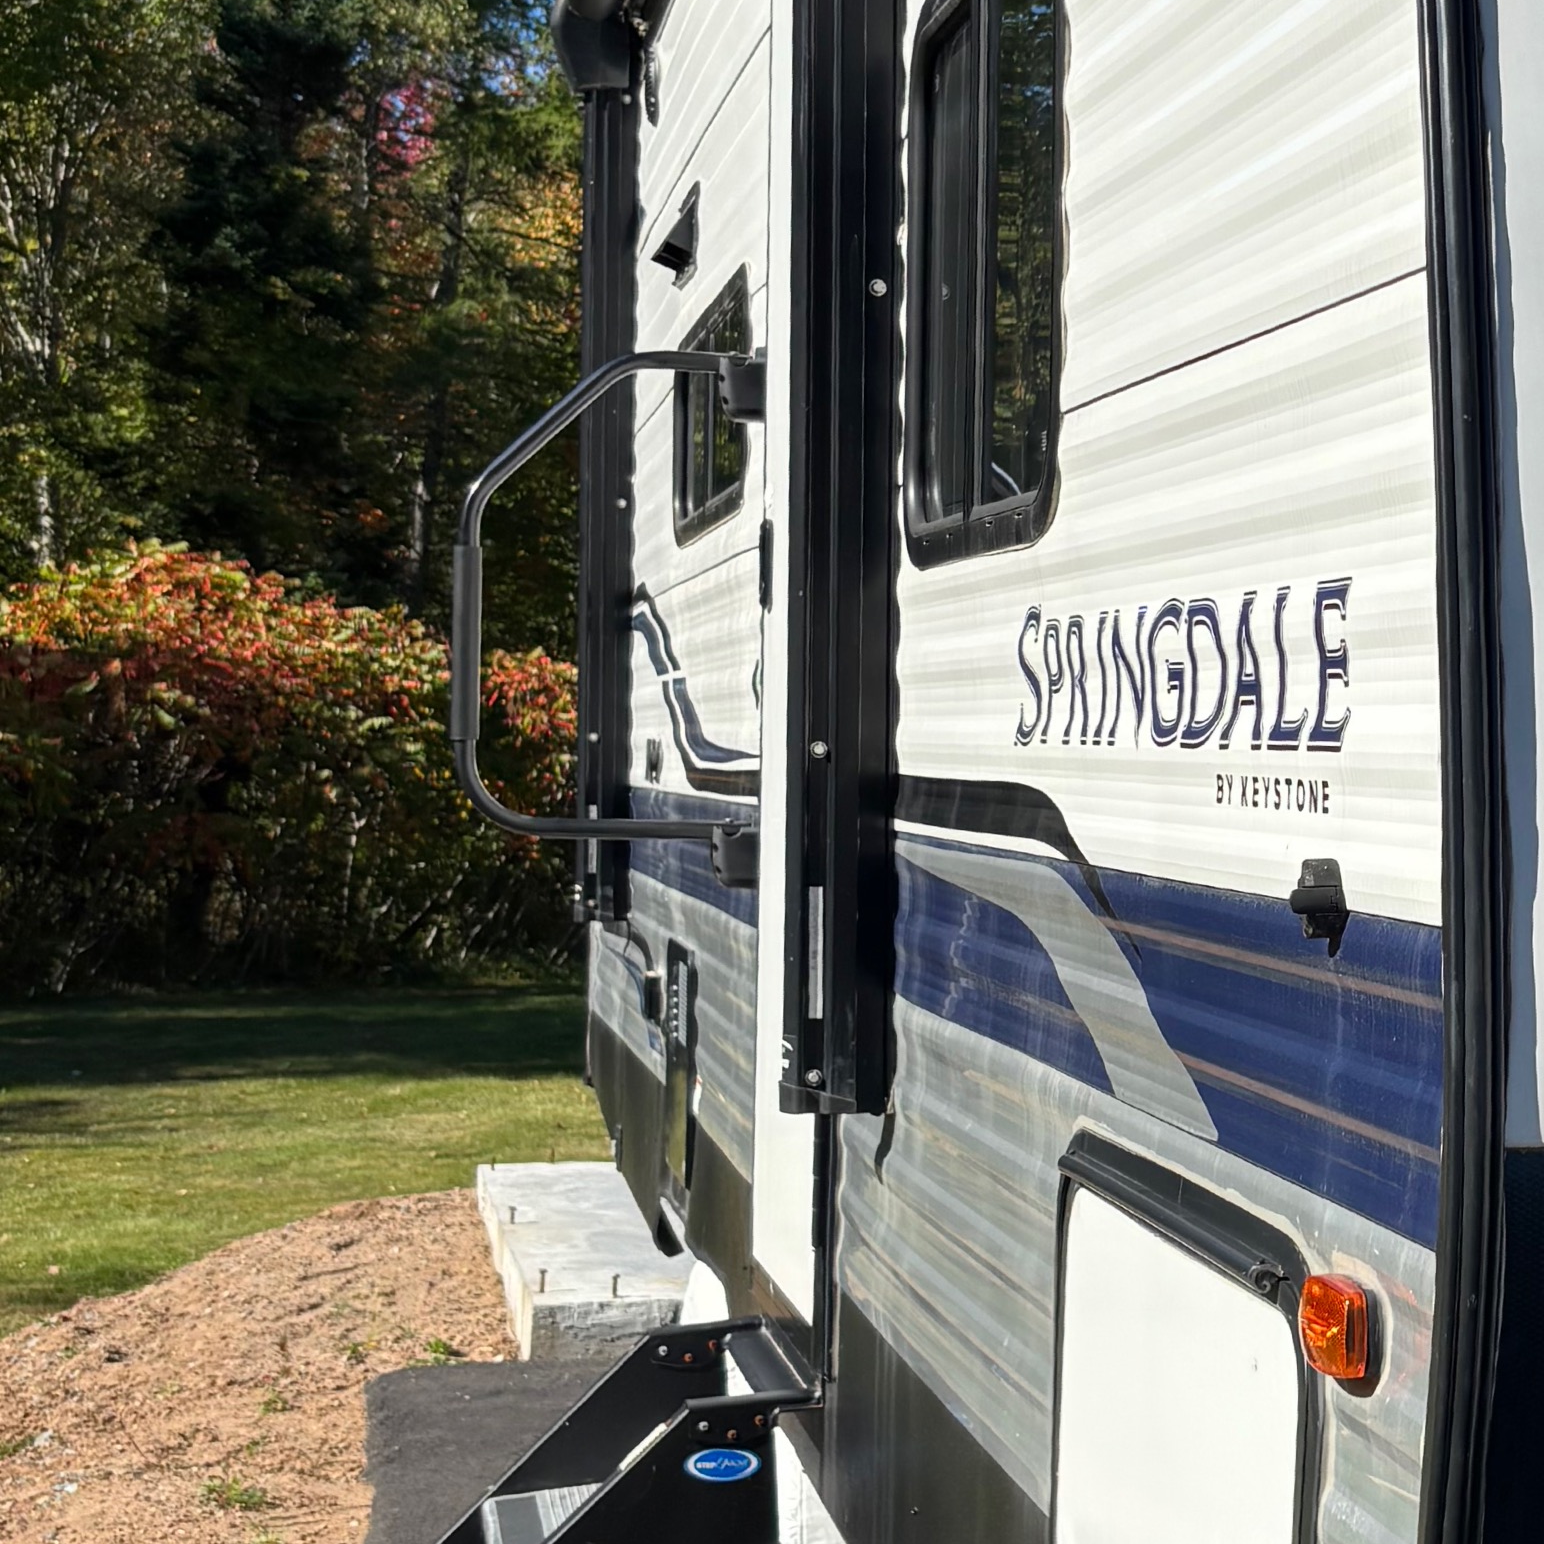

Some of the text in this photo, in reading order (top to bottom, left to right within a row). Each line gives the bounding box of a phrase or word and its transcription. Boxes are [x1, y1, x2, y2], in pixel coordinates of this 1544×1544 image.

[1013, 576, 1353, 753] SPRINGDALE
[1216, 773, 1330, 815] BY KEYSTONE
